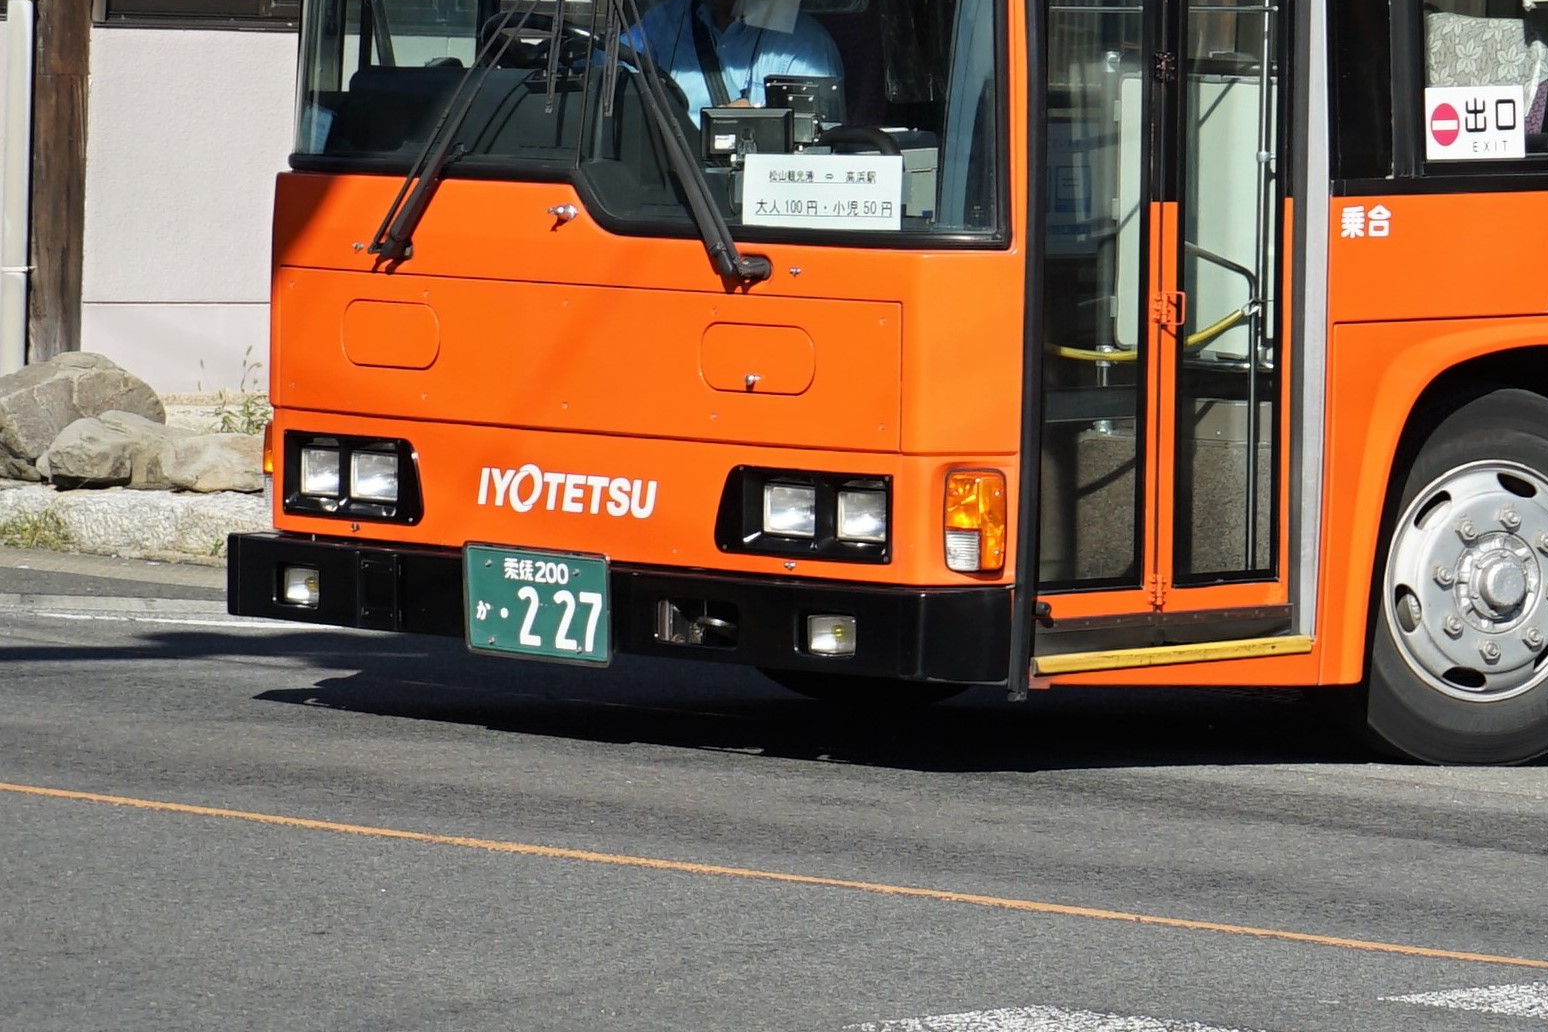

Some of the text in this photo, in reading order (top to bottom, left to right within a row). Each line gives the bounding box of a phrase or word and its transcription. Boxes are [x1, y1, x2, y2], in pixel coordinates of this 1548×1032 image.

[1465, 97, 1516, 133] 出口
[1472, 140, 1508, 153] EXIT
[1340, 204, 1392, 239] 乗合
[478, 463, 657, 519] IYOTETSU
